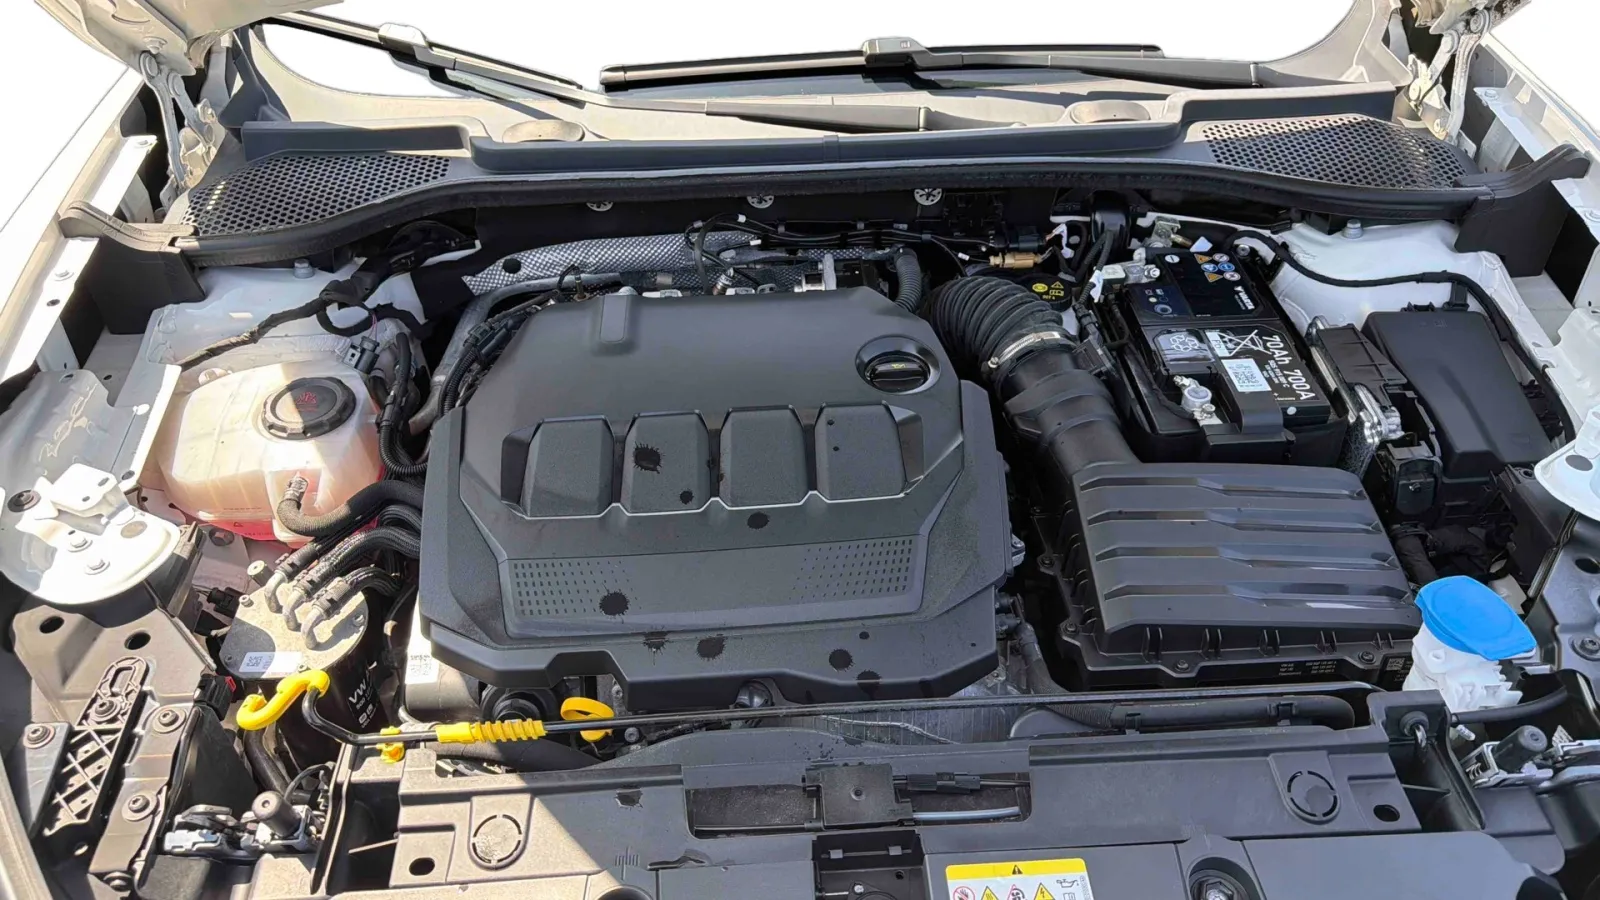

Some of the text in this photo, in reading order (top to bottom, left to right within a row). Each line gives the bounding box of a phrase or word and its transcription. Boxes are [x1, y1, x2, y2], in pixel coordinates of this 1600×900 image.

[1262, 335, 1292, 364] 70Ah
[1284, 369, 1315, 400] 700A
[349, 679, 366, 703] VW
